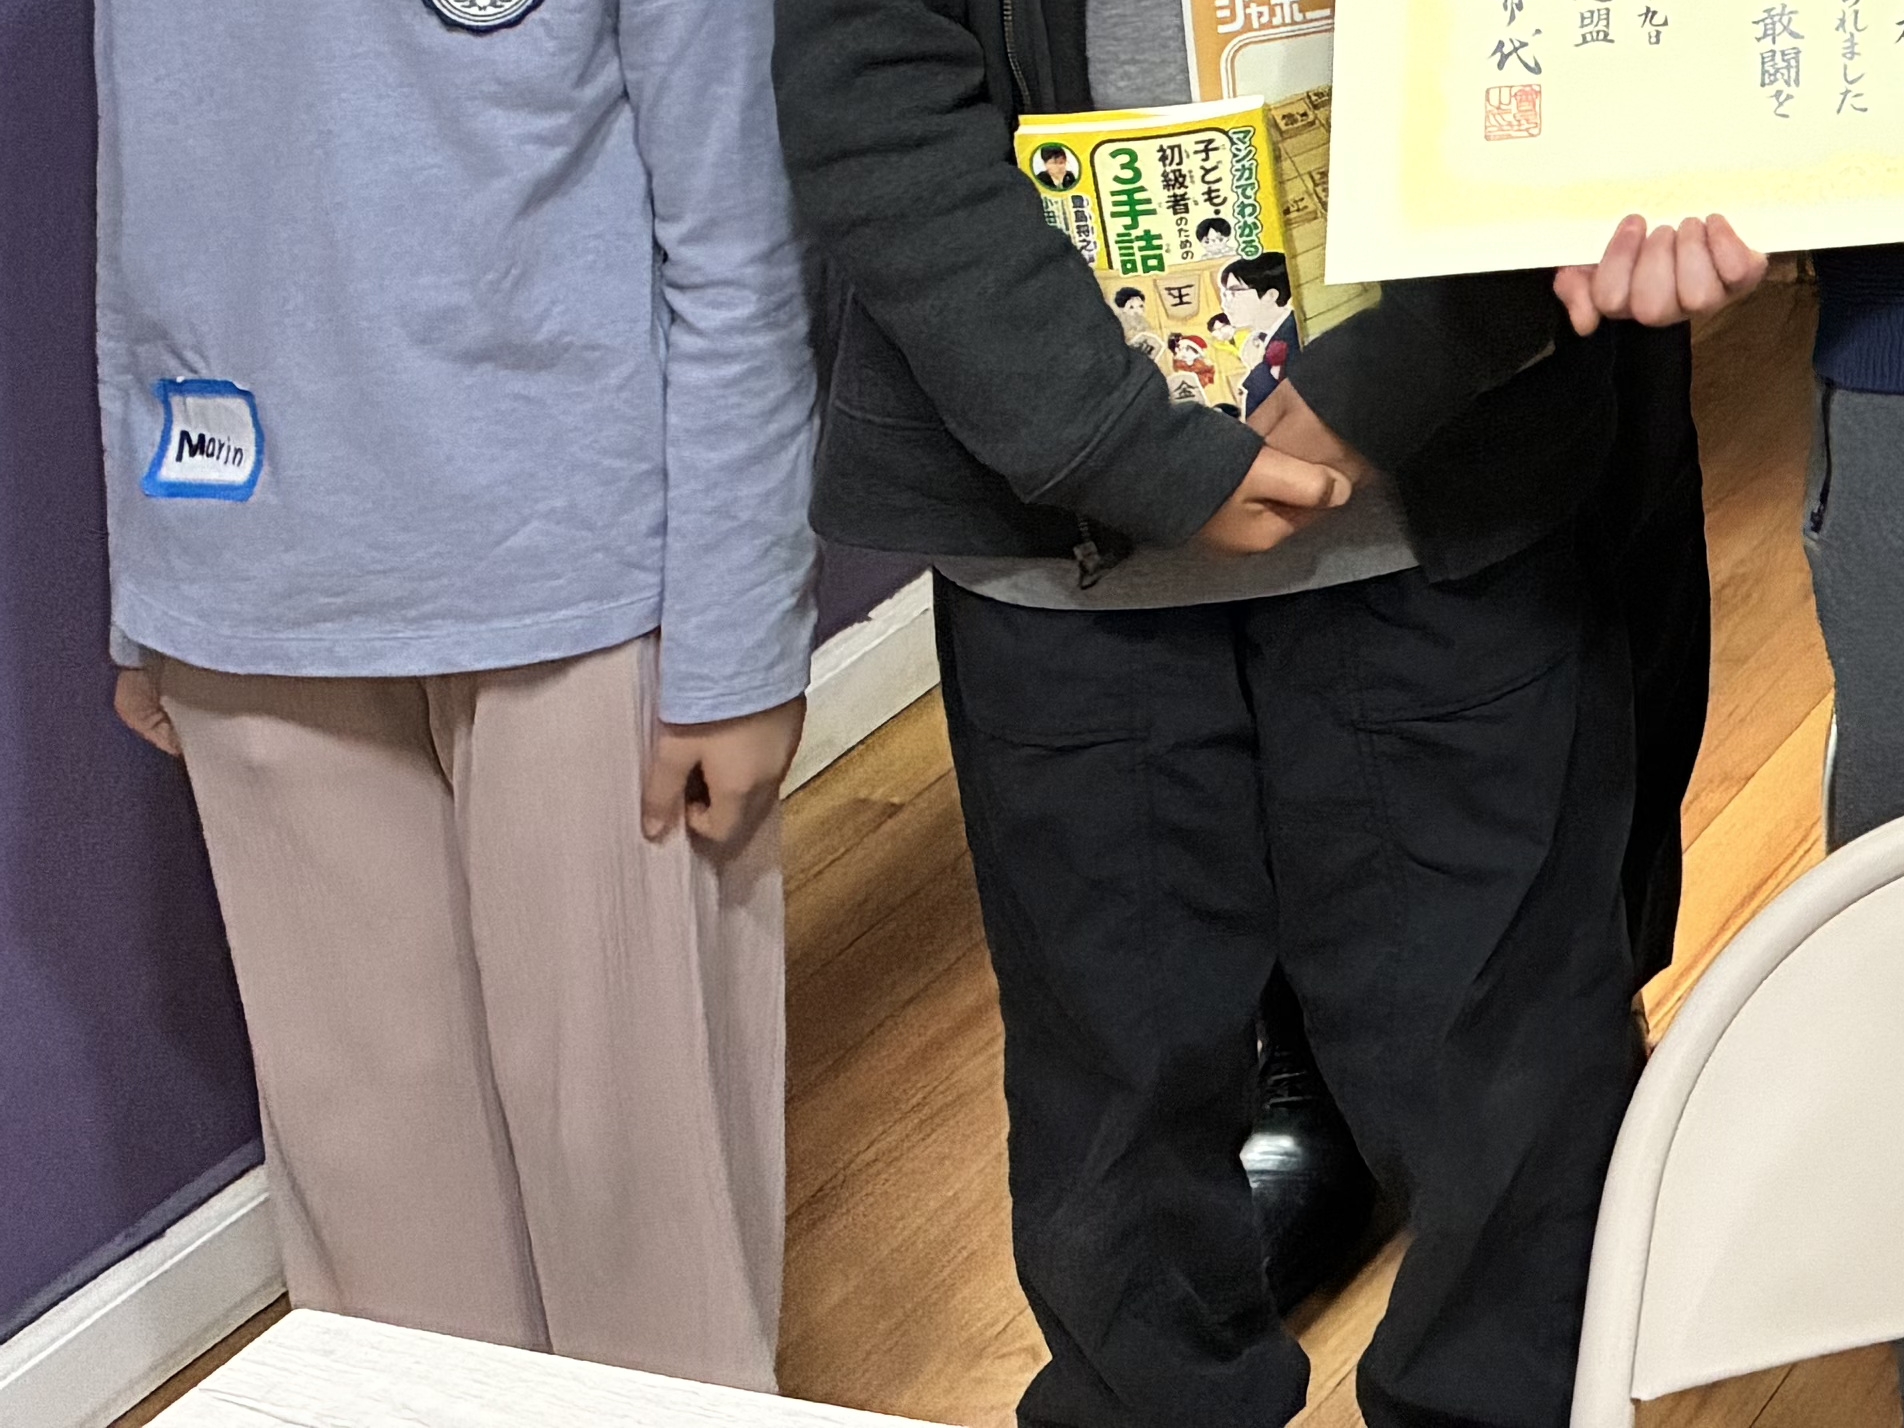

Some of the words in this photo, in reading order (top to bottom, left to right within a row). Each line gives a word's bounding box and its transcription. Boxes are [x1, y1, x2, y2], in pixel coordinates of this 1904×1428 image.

[1108, 147, 1166, 276] 3手詰
[1156, 143, 1195, 262] 初級者のための
[1231, 128, 1262, 258] マンガでわかる
[175, 429, 244, 468] Marin
